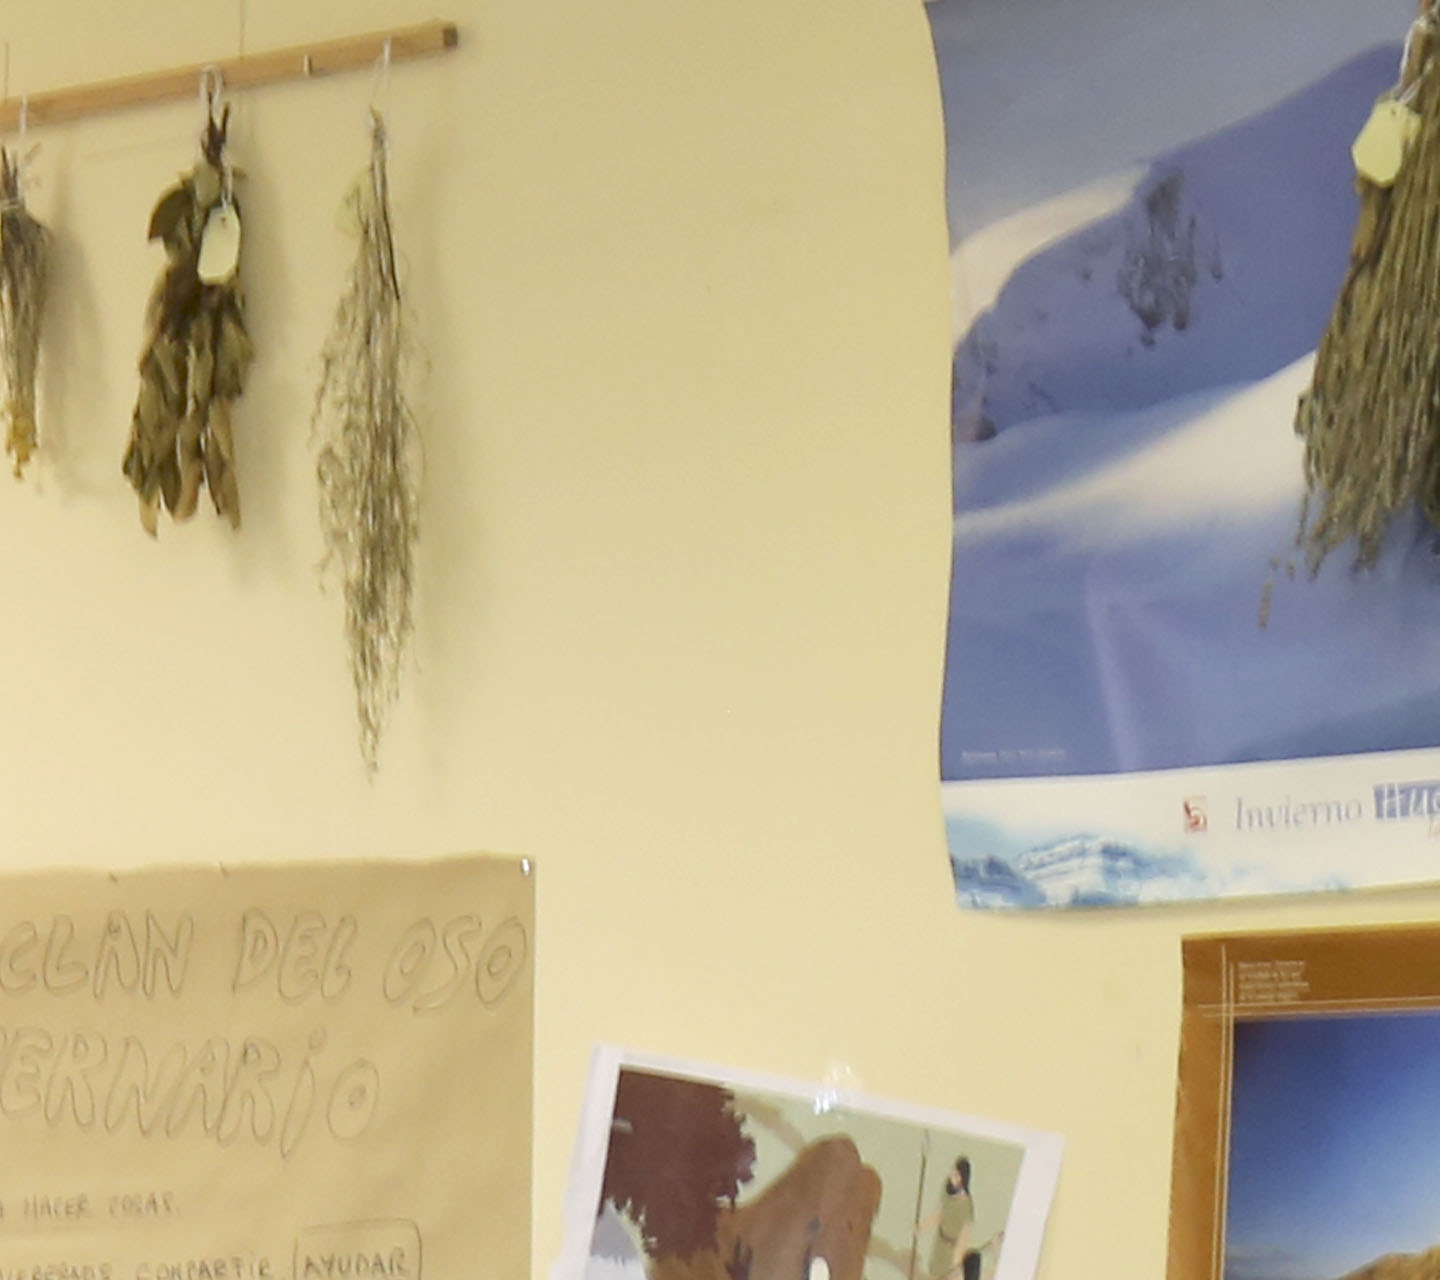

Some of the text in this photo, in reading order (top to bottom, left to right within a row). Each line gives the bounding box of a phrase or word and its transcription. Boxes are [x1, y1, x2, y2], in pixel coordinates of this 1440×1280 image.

[1235, 794, 1363, 831] Invierno
[231, 906, 359, 1004] DEL
[382, 913, 529, 1015] OSO
[22, 1193, 90, 1222] HACER
[302, 1245, 411, 1280] AYUDAR
